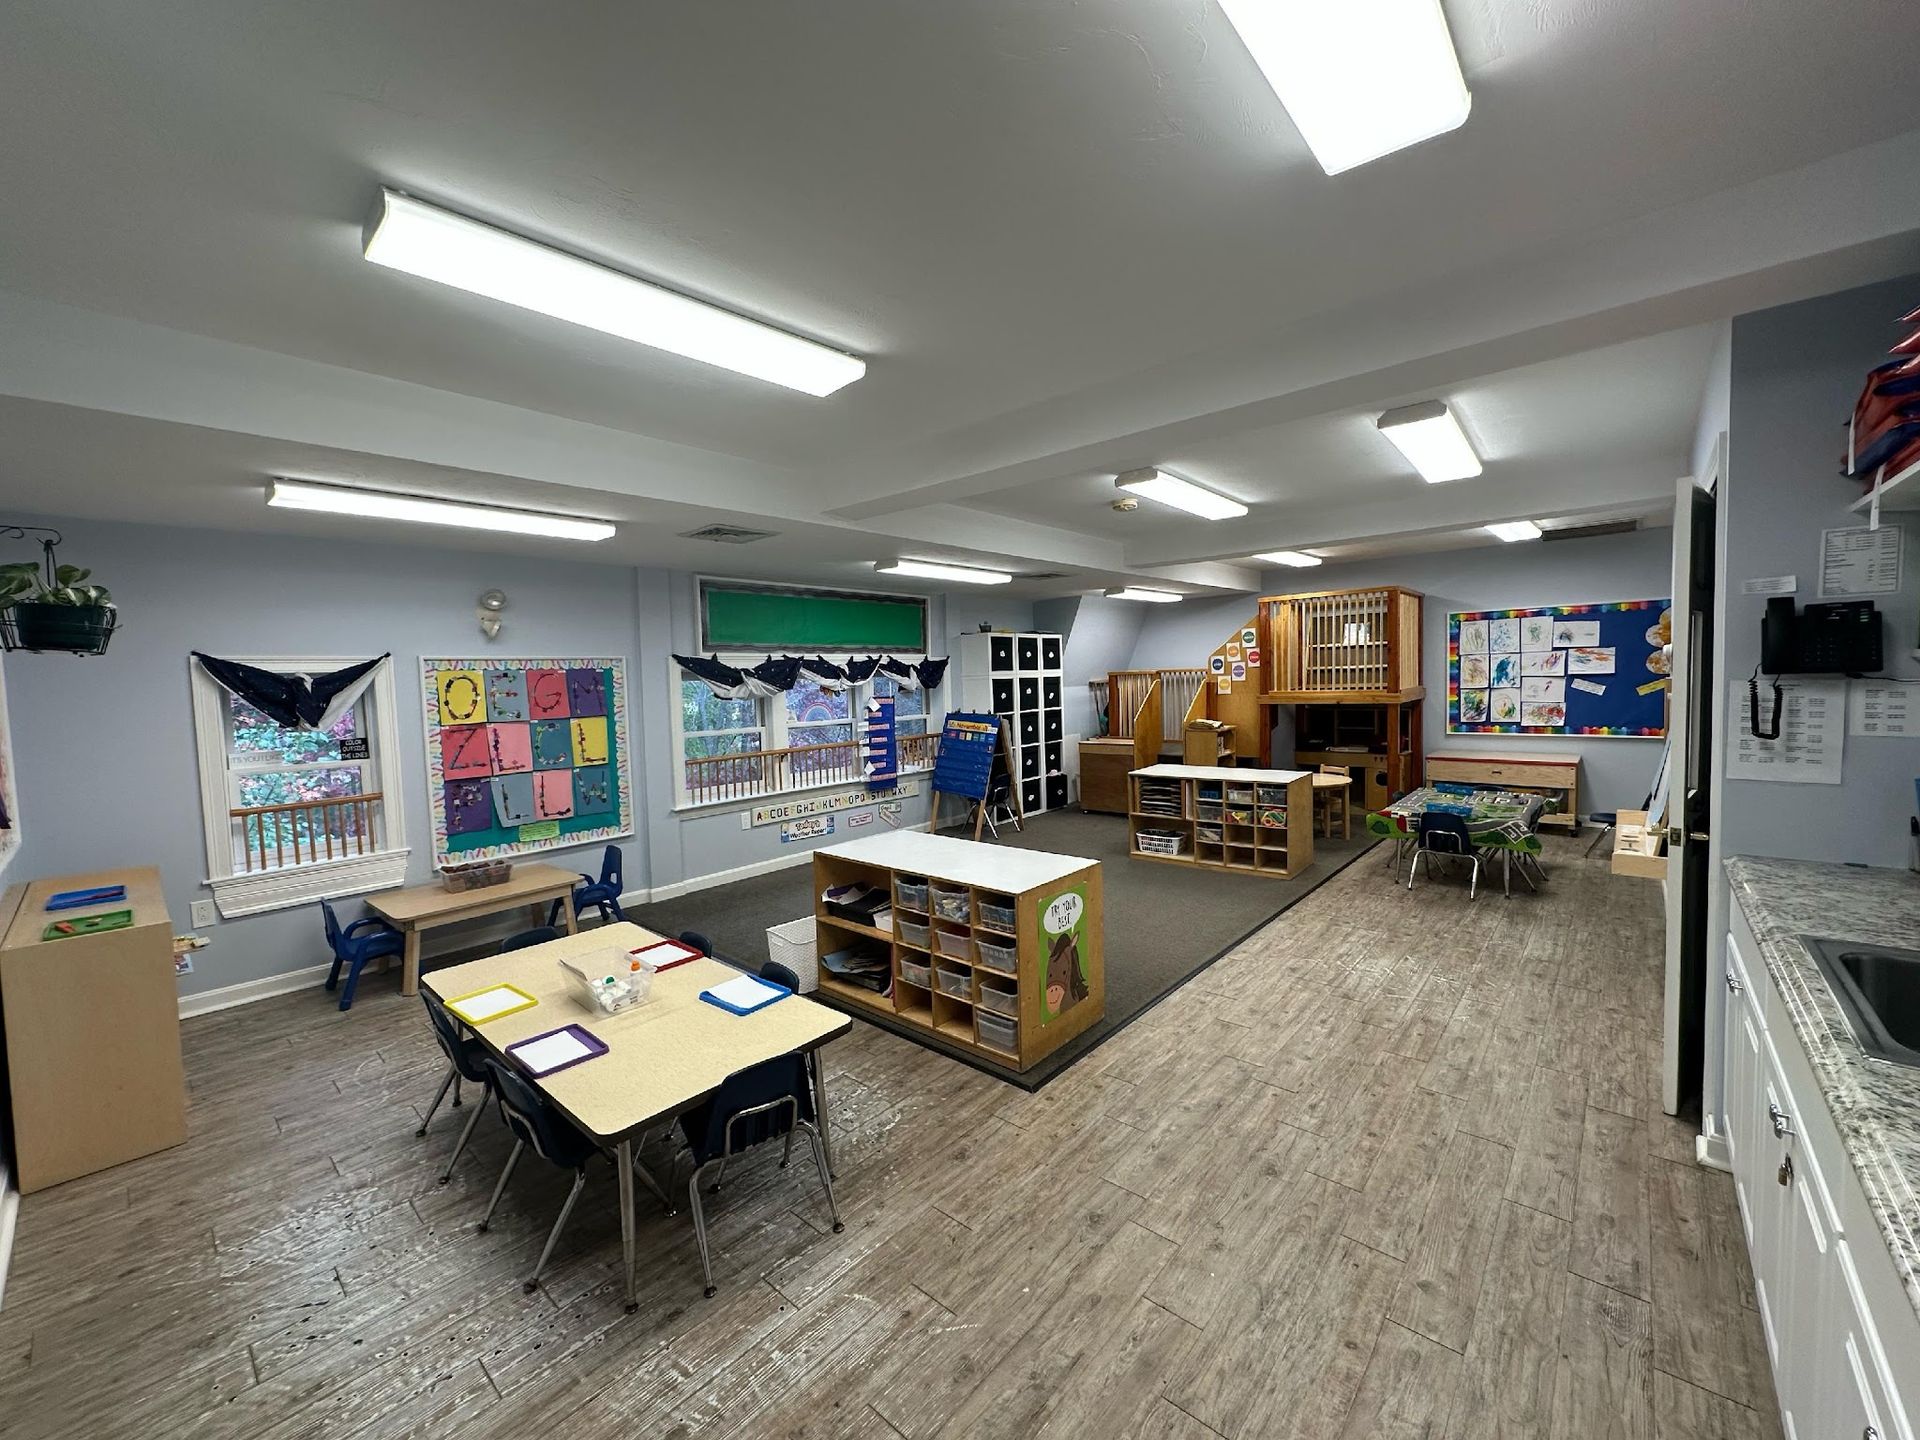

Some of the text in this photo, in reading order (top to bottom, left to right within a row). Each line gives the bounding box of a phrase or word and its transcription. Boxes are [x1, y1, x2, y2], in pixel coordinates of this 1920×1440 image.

[534, 673, 562, 713] G
[342, 744, 366, 752] OUTSIDE
[577, 722, 607, 763] L
[352, 751, 368, 759] LINES
[540, 775, 571, 818] L
[1051, 896, 1077, 918] TRY YOUR
[1057, 912, 1071, 930] BEST
